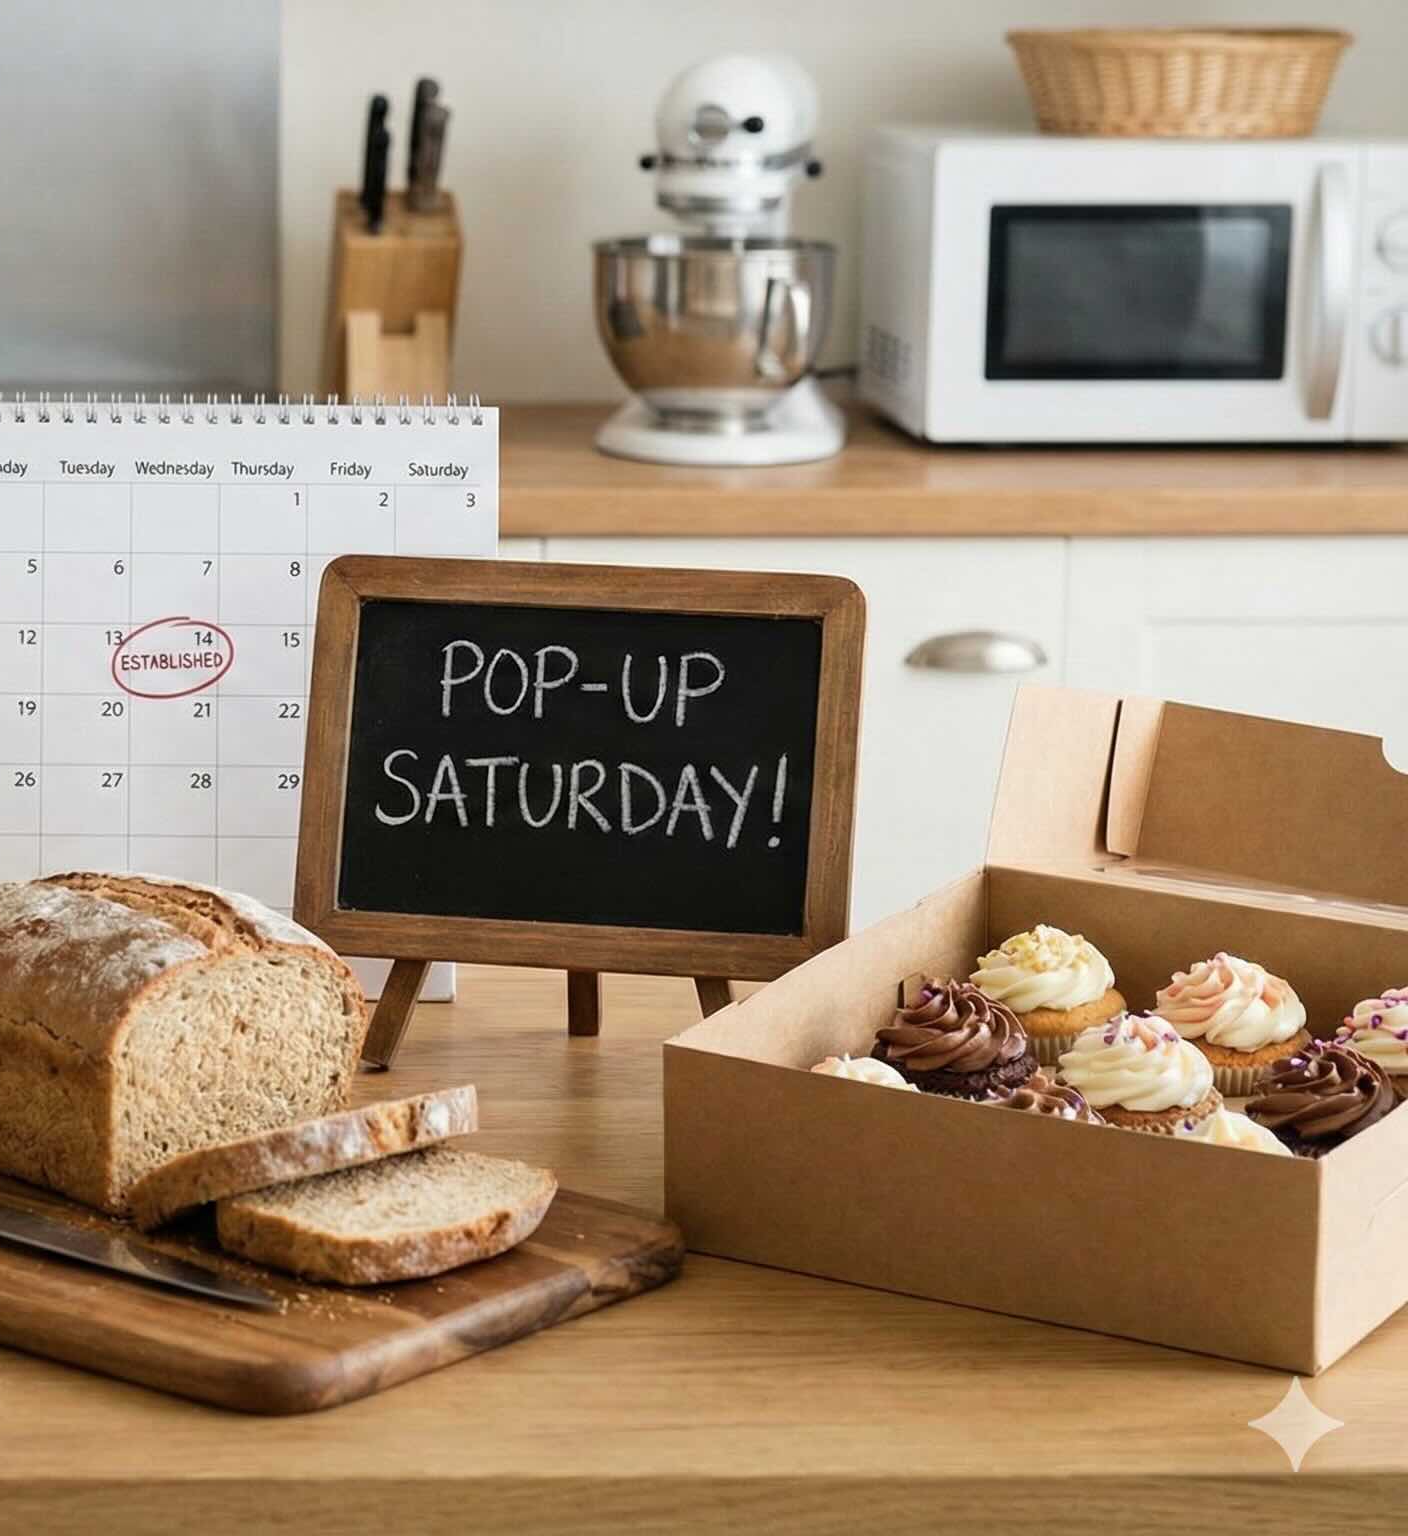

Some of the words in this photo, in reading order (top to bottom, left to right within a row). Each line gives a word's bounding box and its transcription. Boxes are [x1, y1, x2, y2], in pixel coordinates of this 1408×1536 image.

[58, 460, 116, 479] Tuesday
[134, 460, 215, 480] Wednesday
[230, 461, 295, 480] Thursday
[330, 461, 373, 480] Friday
[408, 462, 469, 481] Saturday
[293, 491, 301, 507] 1
[378, 491, 389, 508] 2
[466, 492, 476, 508] 3
[27, 558, 38, 574] 5
[113, 559, 125, 576] 6
[202, 559, 213, 576] 7
[289, 560, 302, 577] 8
[18, 629, 37, 645] 12
[105, 630, 123, 646] 13
[194, 631, 213, 647] 14
[282, 631, 301, 648] 15
[120, 652, 223, 671] ESTABLISHED
[440, 639, 725, 727] POP-UP
[17, 700, 37, 716] 19
[101, 700, 124, 718] 20
[193, 702, 211, 718] 21
[278, 702, 301, 719] 22
[13, 771, 37, 788] 26
[101, 772, 124, 788] 27
[190, 772, 213, 790] 28
[277, 773, 301, 790] 29
[375, 749, 787, 849] SATURDAY!
